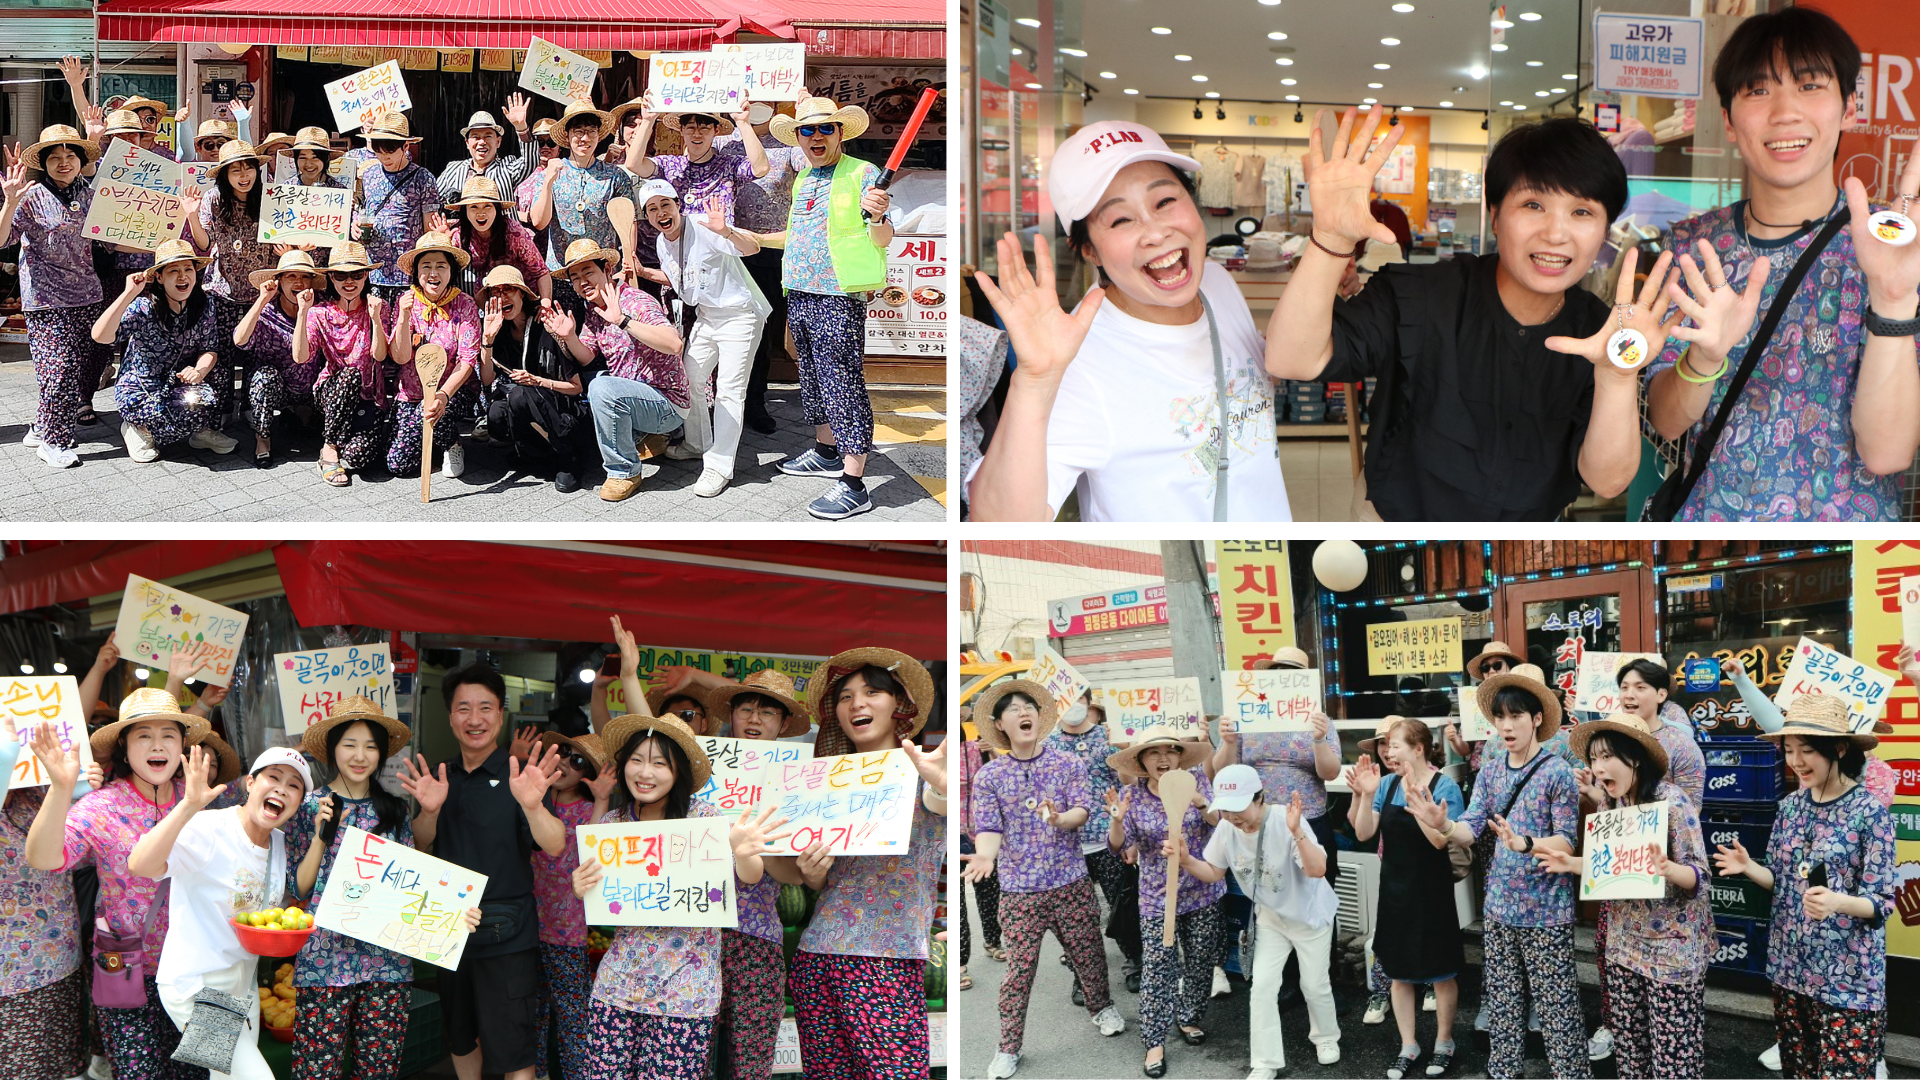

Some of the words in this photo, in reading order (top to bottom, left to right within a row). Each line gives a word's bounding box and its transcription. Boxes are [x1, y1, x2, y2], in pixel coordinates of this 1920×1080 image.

[1625, 23, 1673, 43] 고유가
[1609, 43, 1688, 66] 피해지원금
[341, 64, 392, 94] 단골손님
[663, 59, 707, 80] 아프지
[708, 57, 741, 79] 마소
[760, 68, 800, 94] 대박!
[1622, 65, 1640, 76] TRY
[1640, 67, 1673, 78] 매장에서
[371, 82, 400, 102] 매장
[1248, 114, 1279, 127] KIDS
[123, 146, 140, 167] 돈
[138, 159, 162, 176] 세다
[111, 186, 181, 218] 박수치면
[323, 191, 345, 209] 가라
[114, 211, 161, 232] 매출이
[271, 207, 297, 229] 청춘
[296, 210, 342, 234] 봉리단길
[896, 240, 947, 263] 세
[208, 615, 242, 645] 기절
[1084, 611, 1118, 632] 점핑운동
[1119, 606, 1157, 627] 다이어트
[1542, 607, 1602, 632] 스토리
[1443, 622, 1459, 643] 문어
[294, 652, 345, 685] 골목이
[343, 647, 386, 681] 웃으면
[1385, 651, 1405, 670] 산낙지
[1410, 650, 1426, 669] 전복
[1432, 648, 1449, 667] 소라
[1804, 645, 1845, 685] 골목이
[1839, 665, 1885, 705] 웃으면
[1118, 687, 1161, 707] 아프지
[783, 751, 891, 792] 단골손님
[849, 785, 907, 821] 매장
[1636, 807, 1660, 835] 가라
[598, 833, 664, 869] 아프지
[669, 827, 723, 869] 마소
[790, 821, 880, 853] 여기!!
[354, 833, 387, 879] 돈
[381, 859, 421, 891] 세다
[1591, 843, 1613, 879] 청춘
[401, 889, 462, 939] 잠들자
